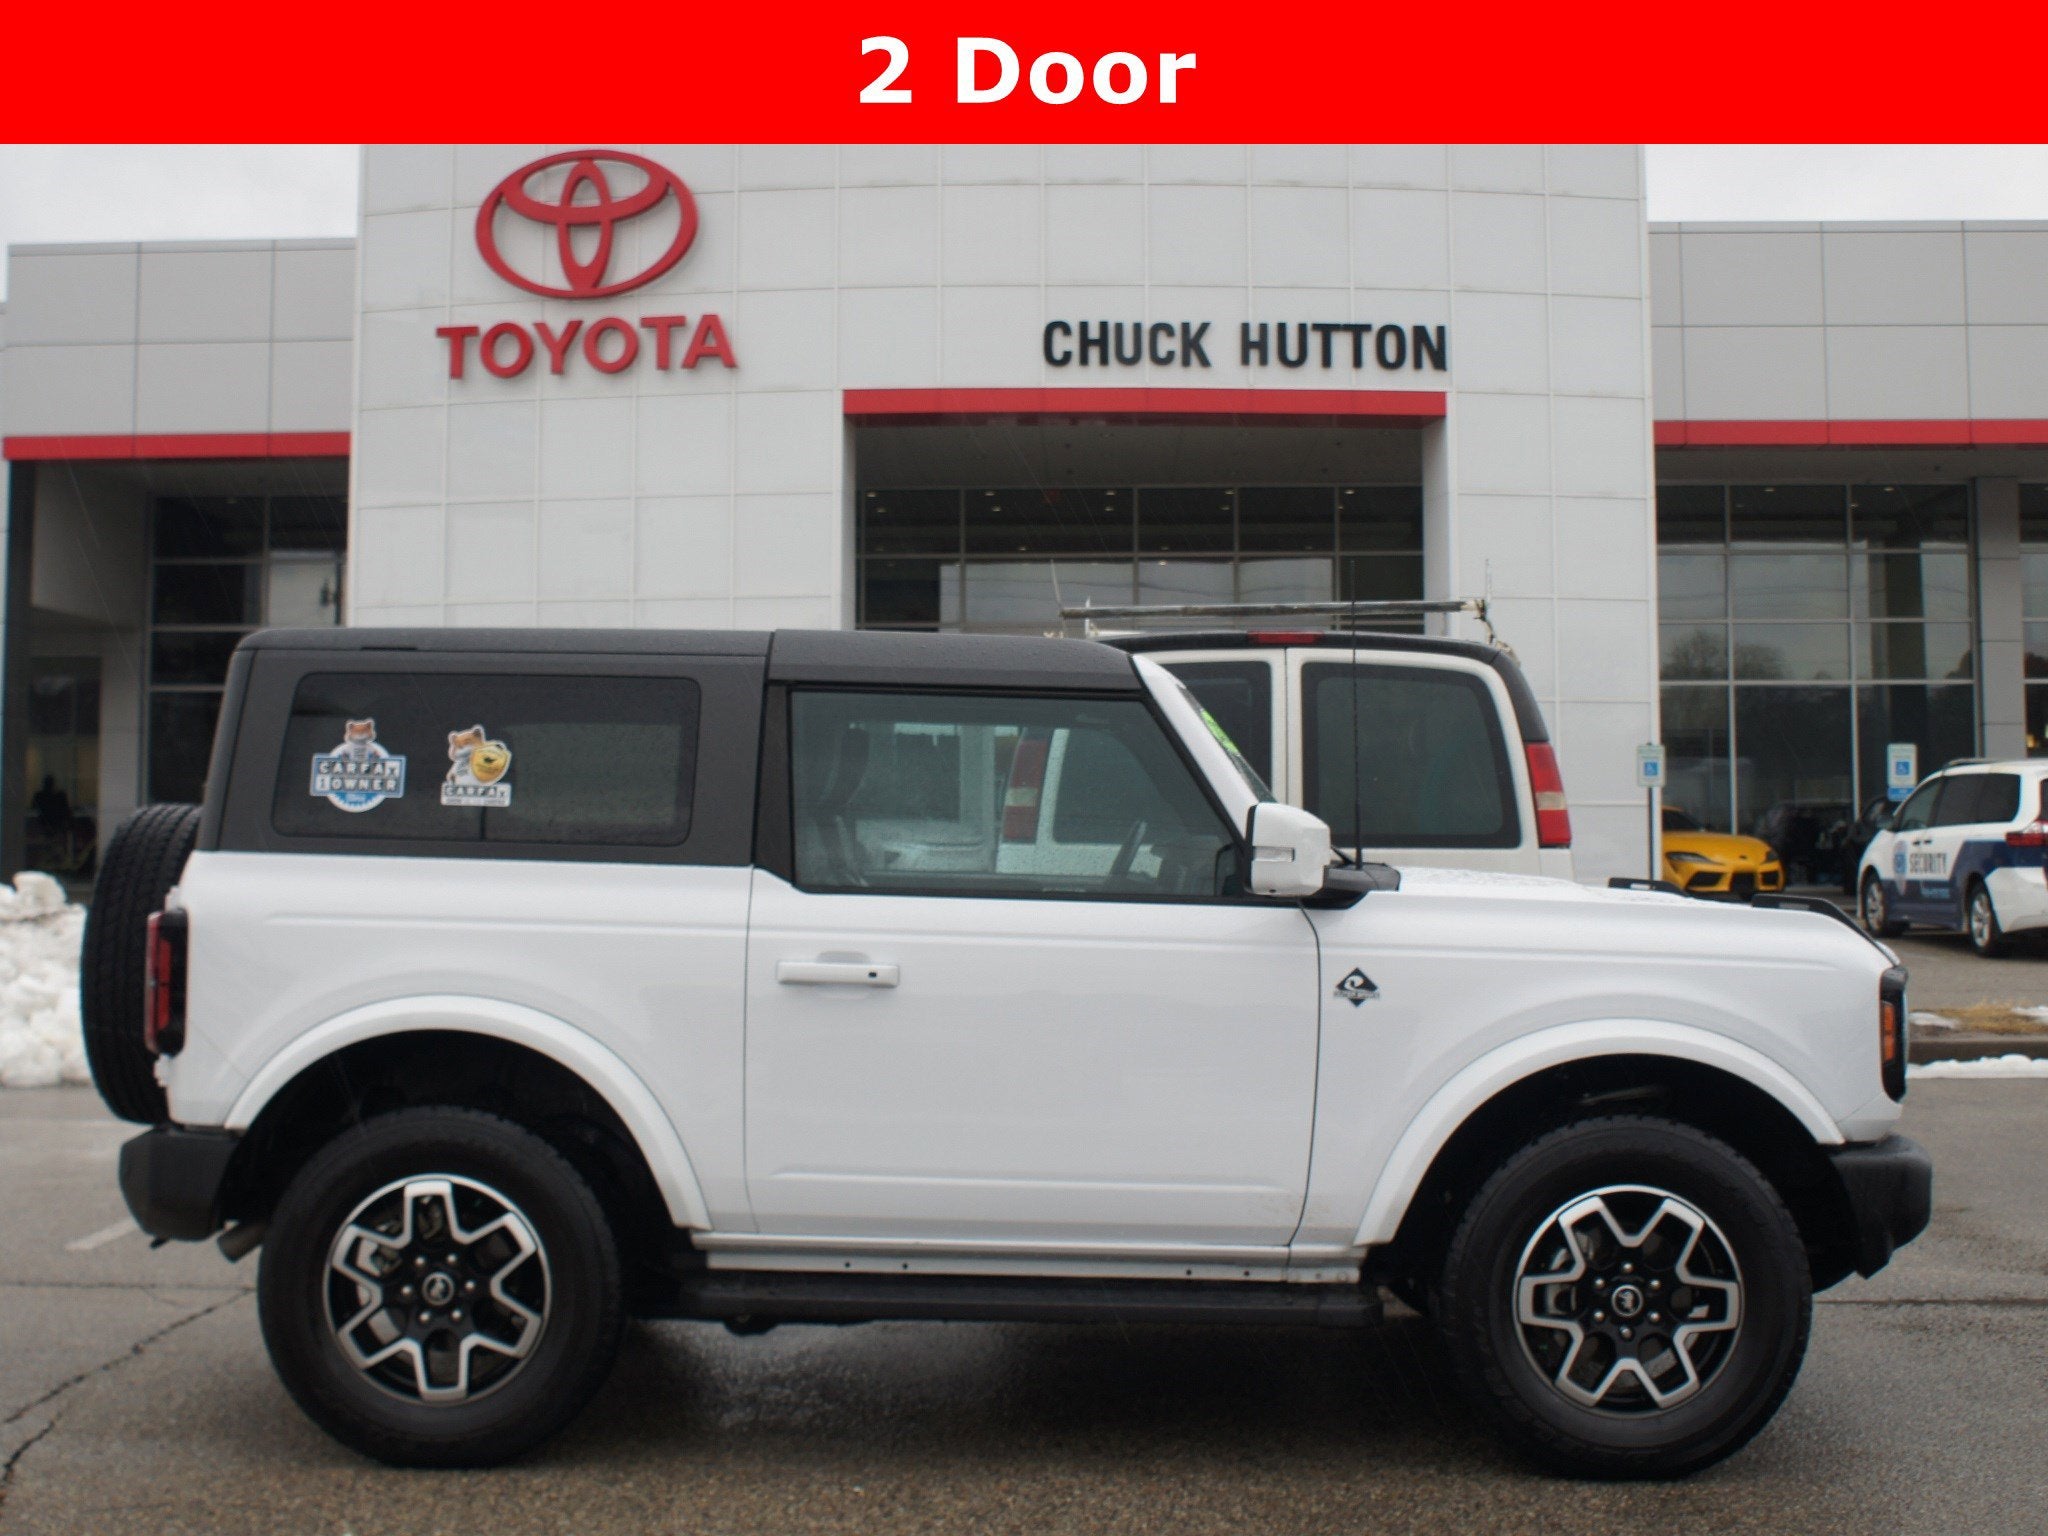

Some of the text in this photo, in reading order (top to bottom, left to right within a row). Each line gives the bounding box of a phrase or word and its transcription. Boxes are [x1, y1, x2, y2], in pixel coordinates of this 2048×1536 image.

[435, 314, 738, 380] TOYOTA
[1043, 320, 1448, 371] CHUCK HUTTON
[319, 761, 401, 777] CARFAX
[331, 778, 398, 791] OWNER
[445, 785, 508, 797] CARFAX
[1910, 853, 1947, 874] SECURITY
